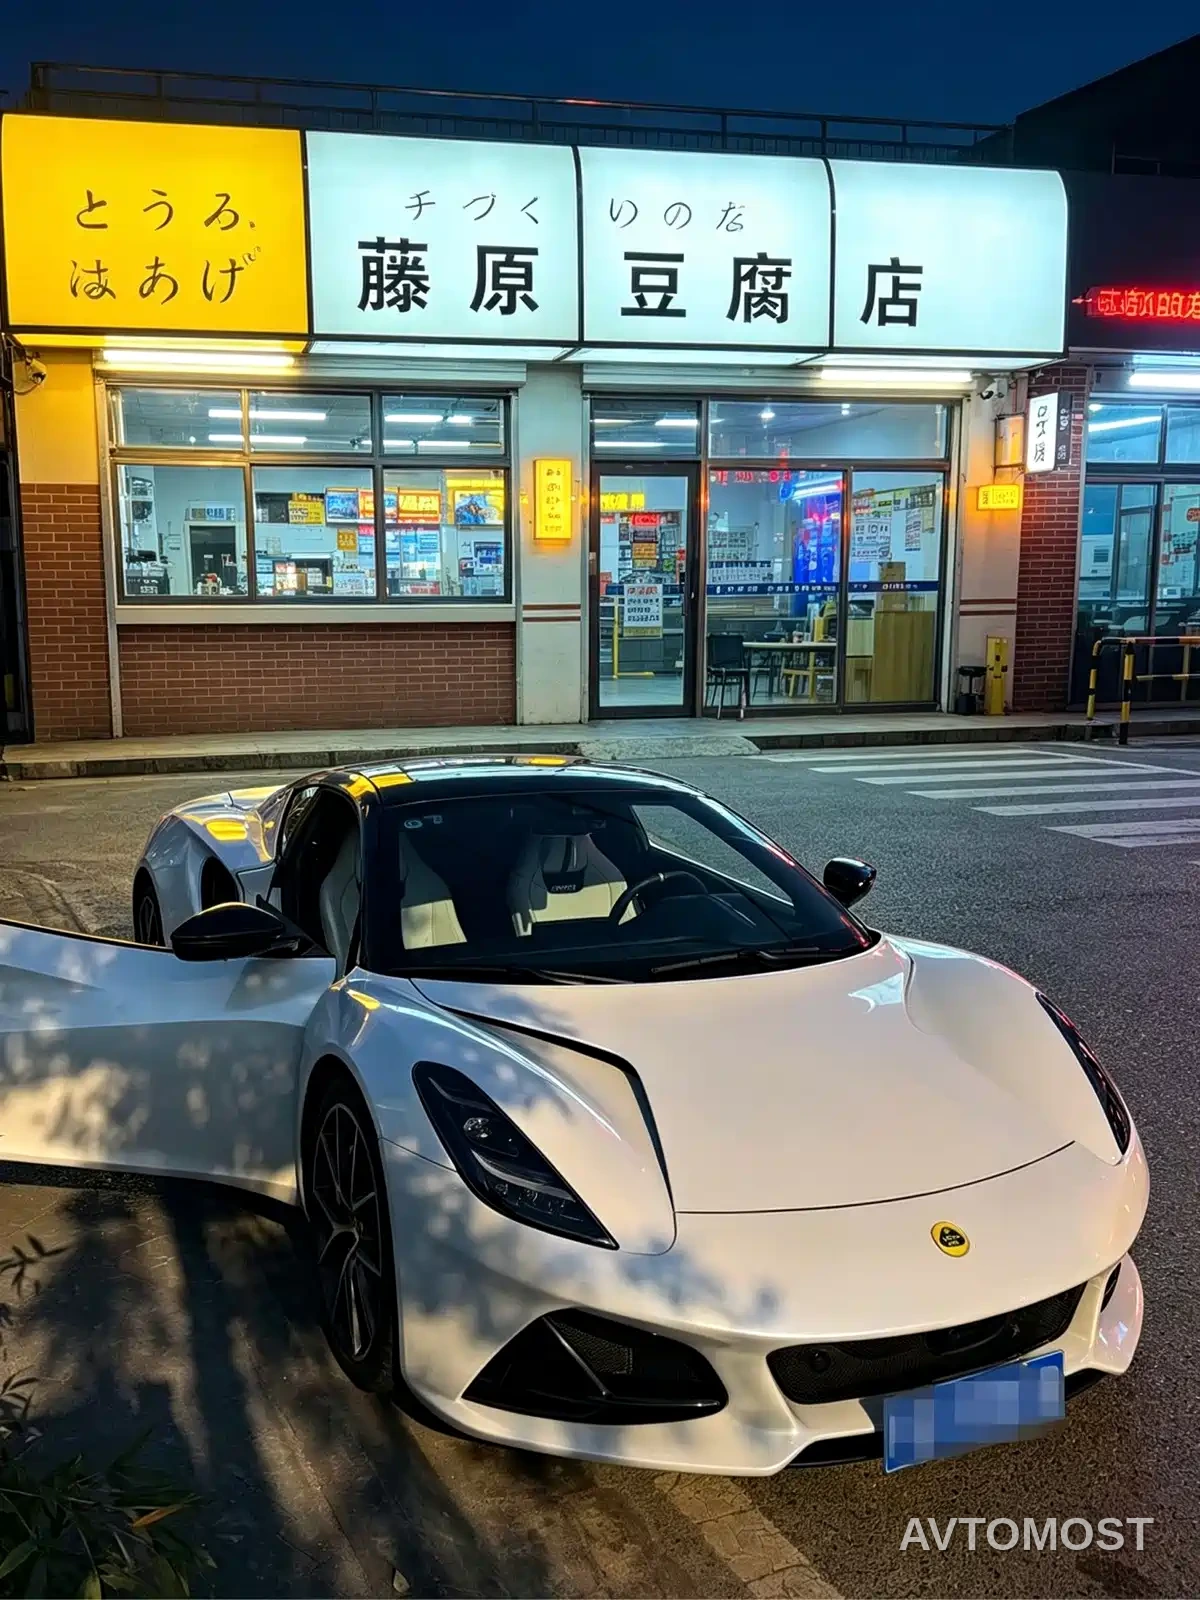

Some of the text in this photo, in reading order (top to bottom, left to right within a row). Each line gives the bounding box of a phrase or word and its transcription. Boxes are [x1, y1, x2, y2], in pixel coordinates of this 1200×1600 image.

[357, 236, 923, 327] 藤原豆腐店
